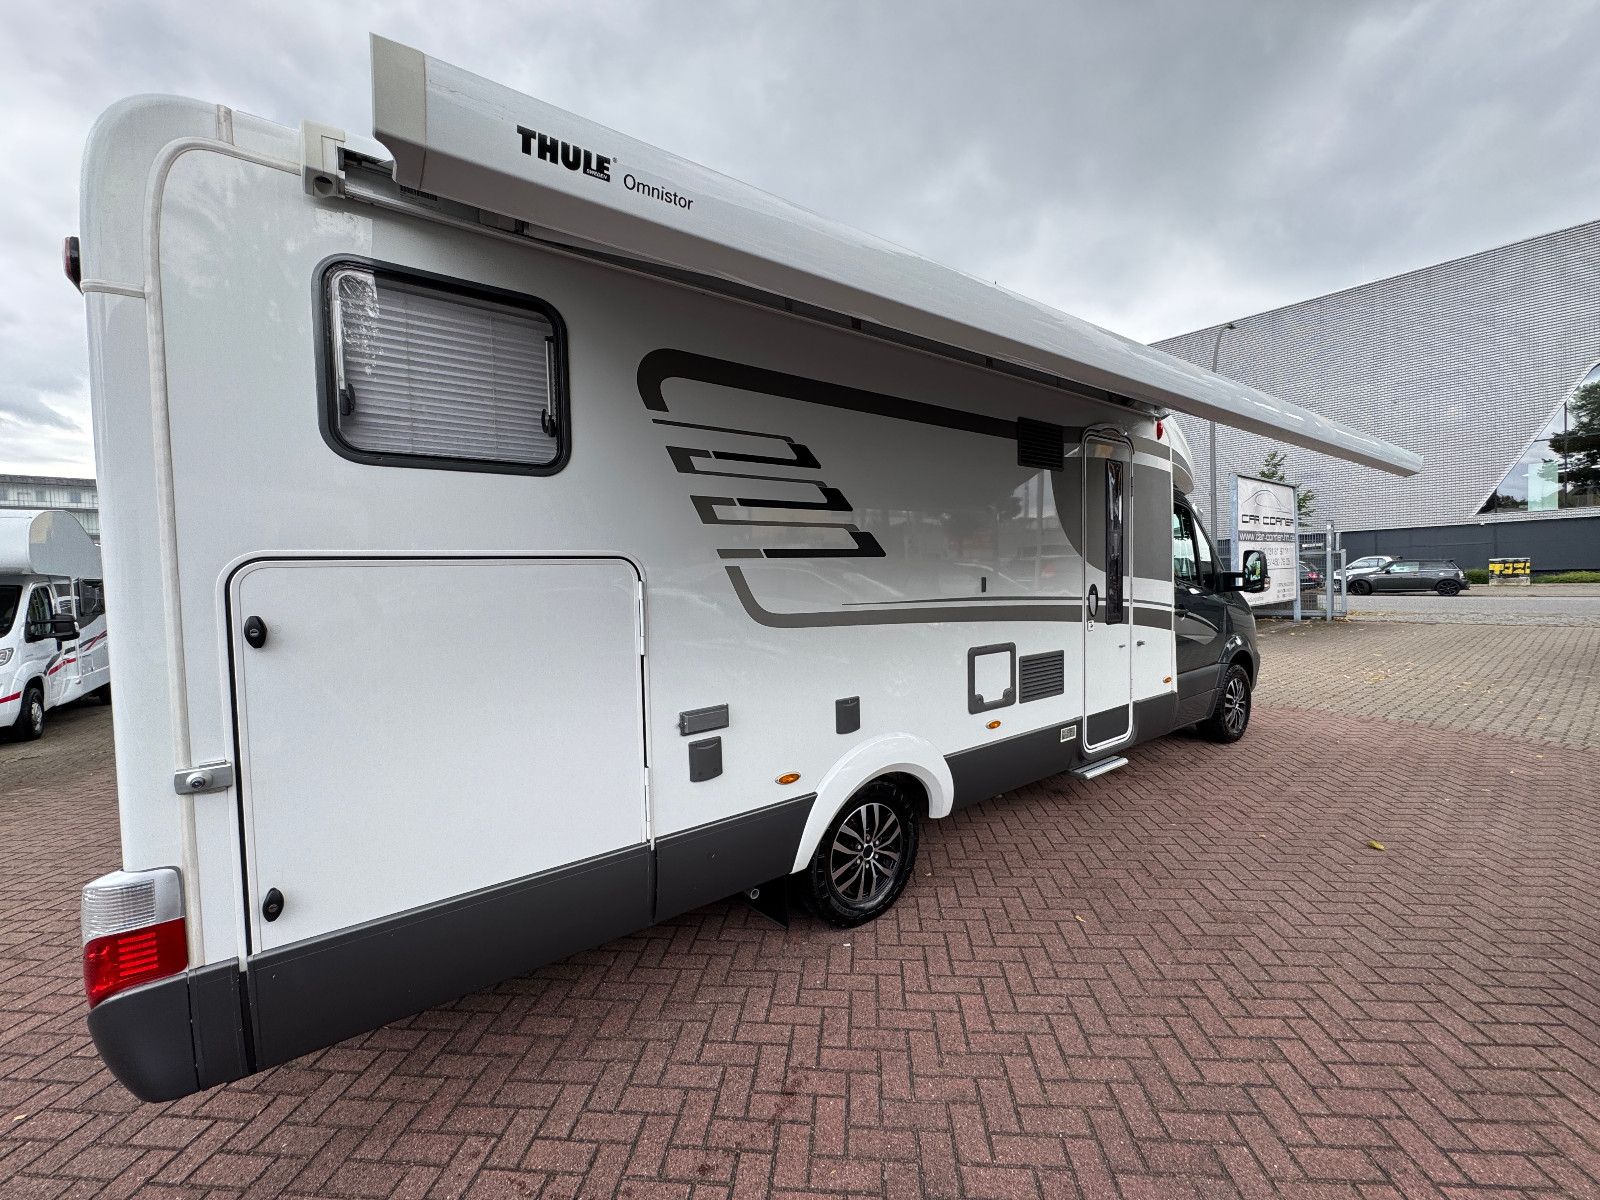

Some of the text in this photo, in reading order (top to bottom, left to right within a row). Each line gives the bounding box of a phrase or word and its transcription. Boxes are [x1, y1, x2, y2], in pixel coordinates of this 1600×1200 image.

[517, 124, 694, 210] THULE Omnistor
[586, 168, 608, 180] SWEDEN
[1242, 514, 1294, 527] CAR CORNER
